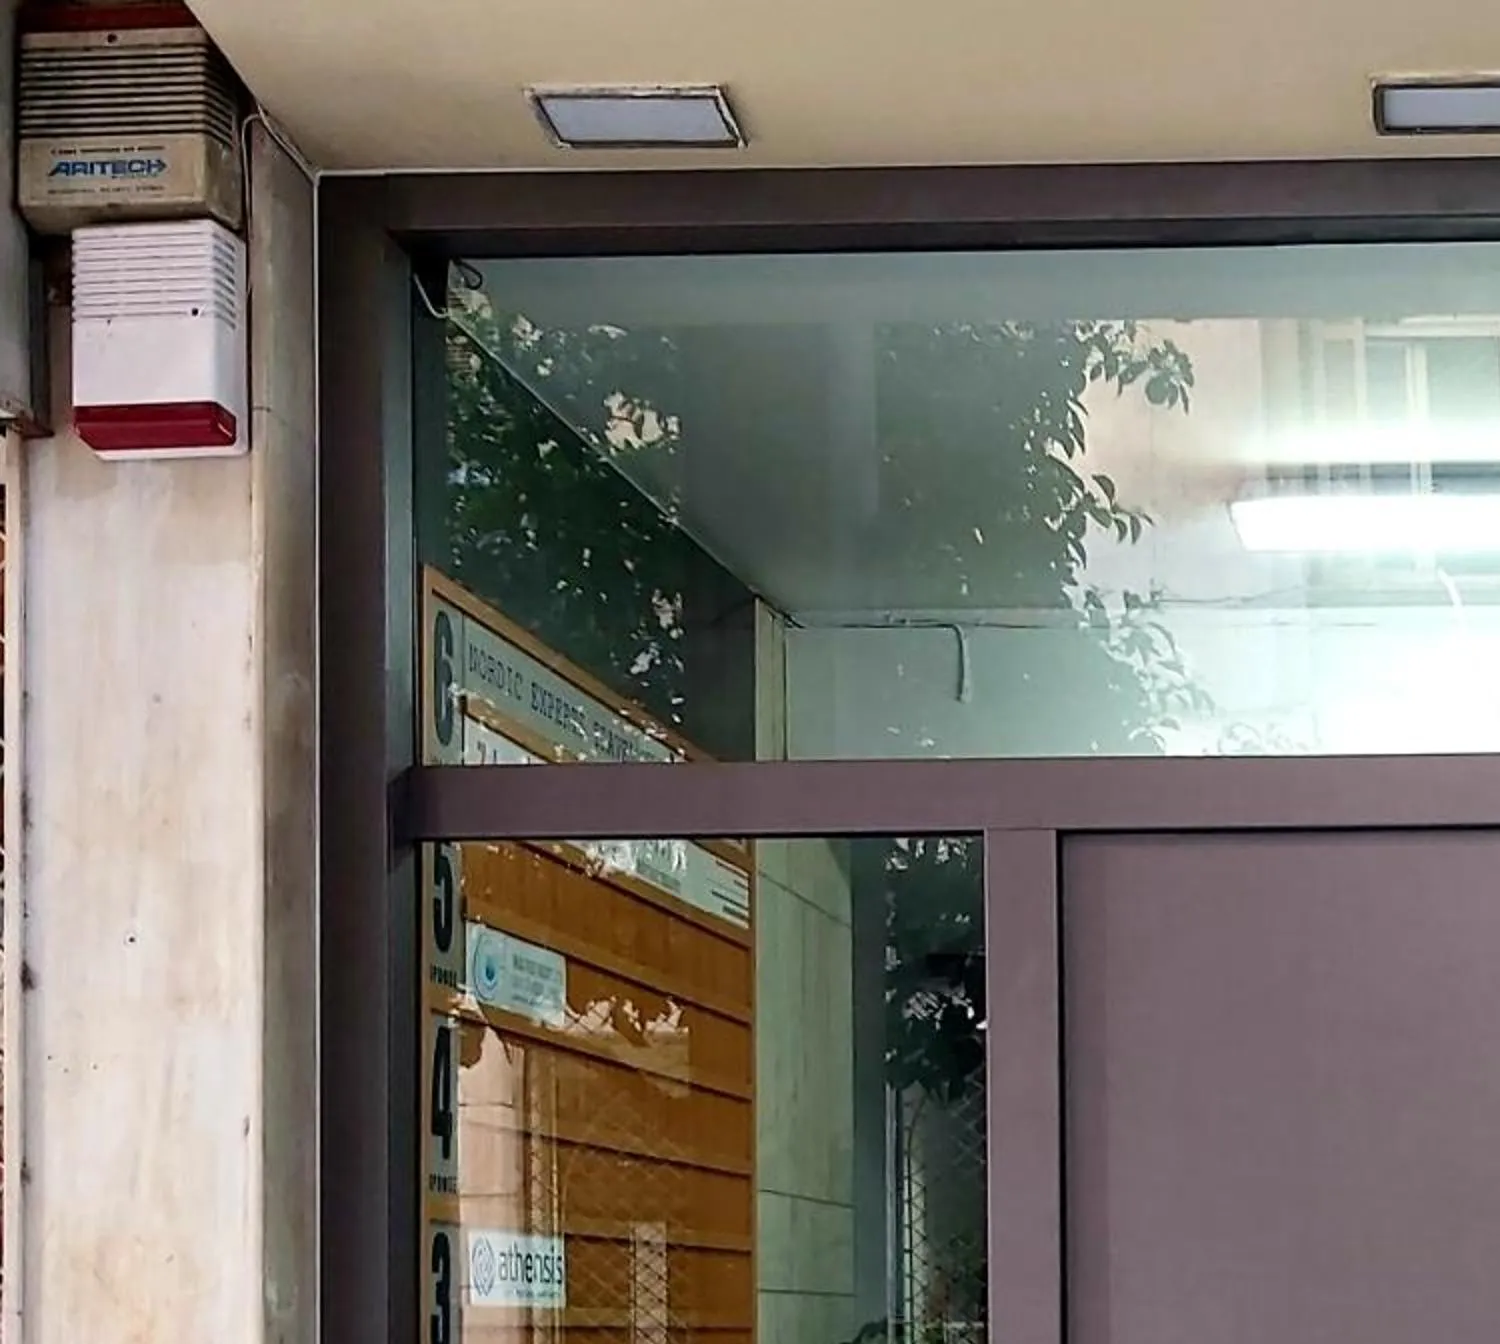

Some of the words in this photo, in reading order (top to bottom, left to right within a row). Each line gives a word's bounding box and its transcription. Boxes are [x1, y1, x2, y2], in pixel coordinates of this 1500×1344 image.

[48, 158, 167, 178] ARITECH
[433, 610, 454, 746] 6
[431, 1026, 452, 1160] 4
[499, 1240, 563, 1285] athensis
